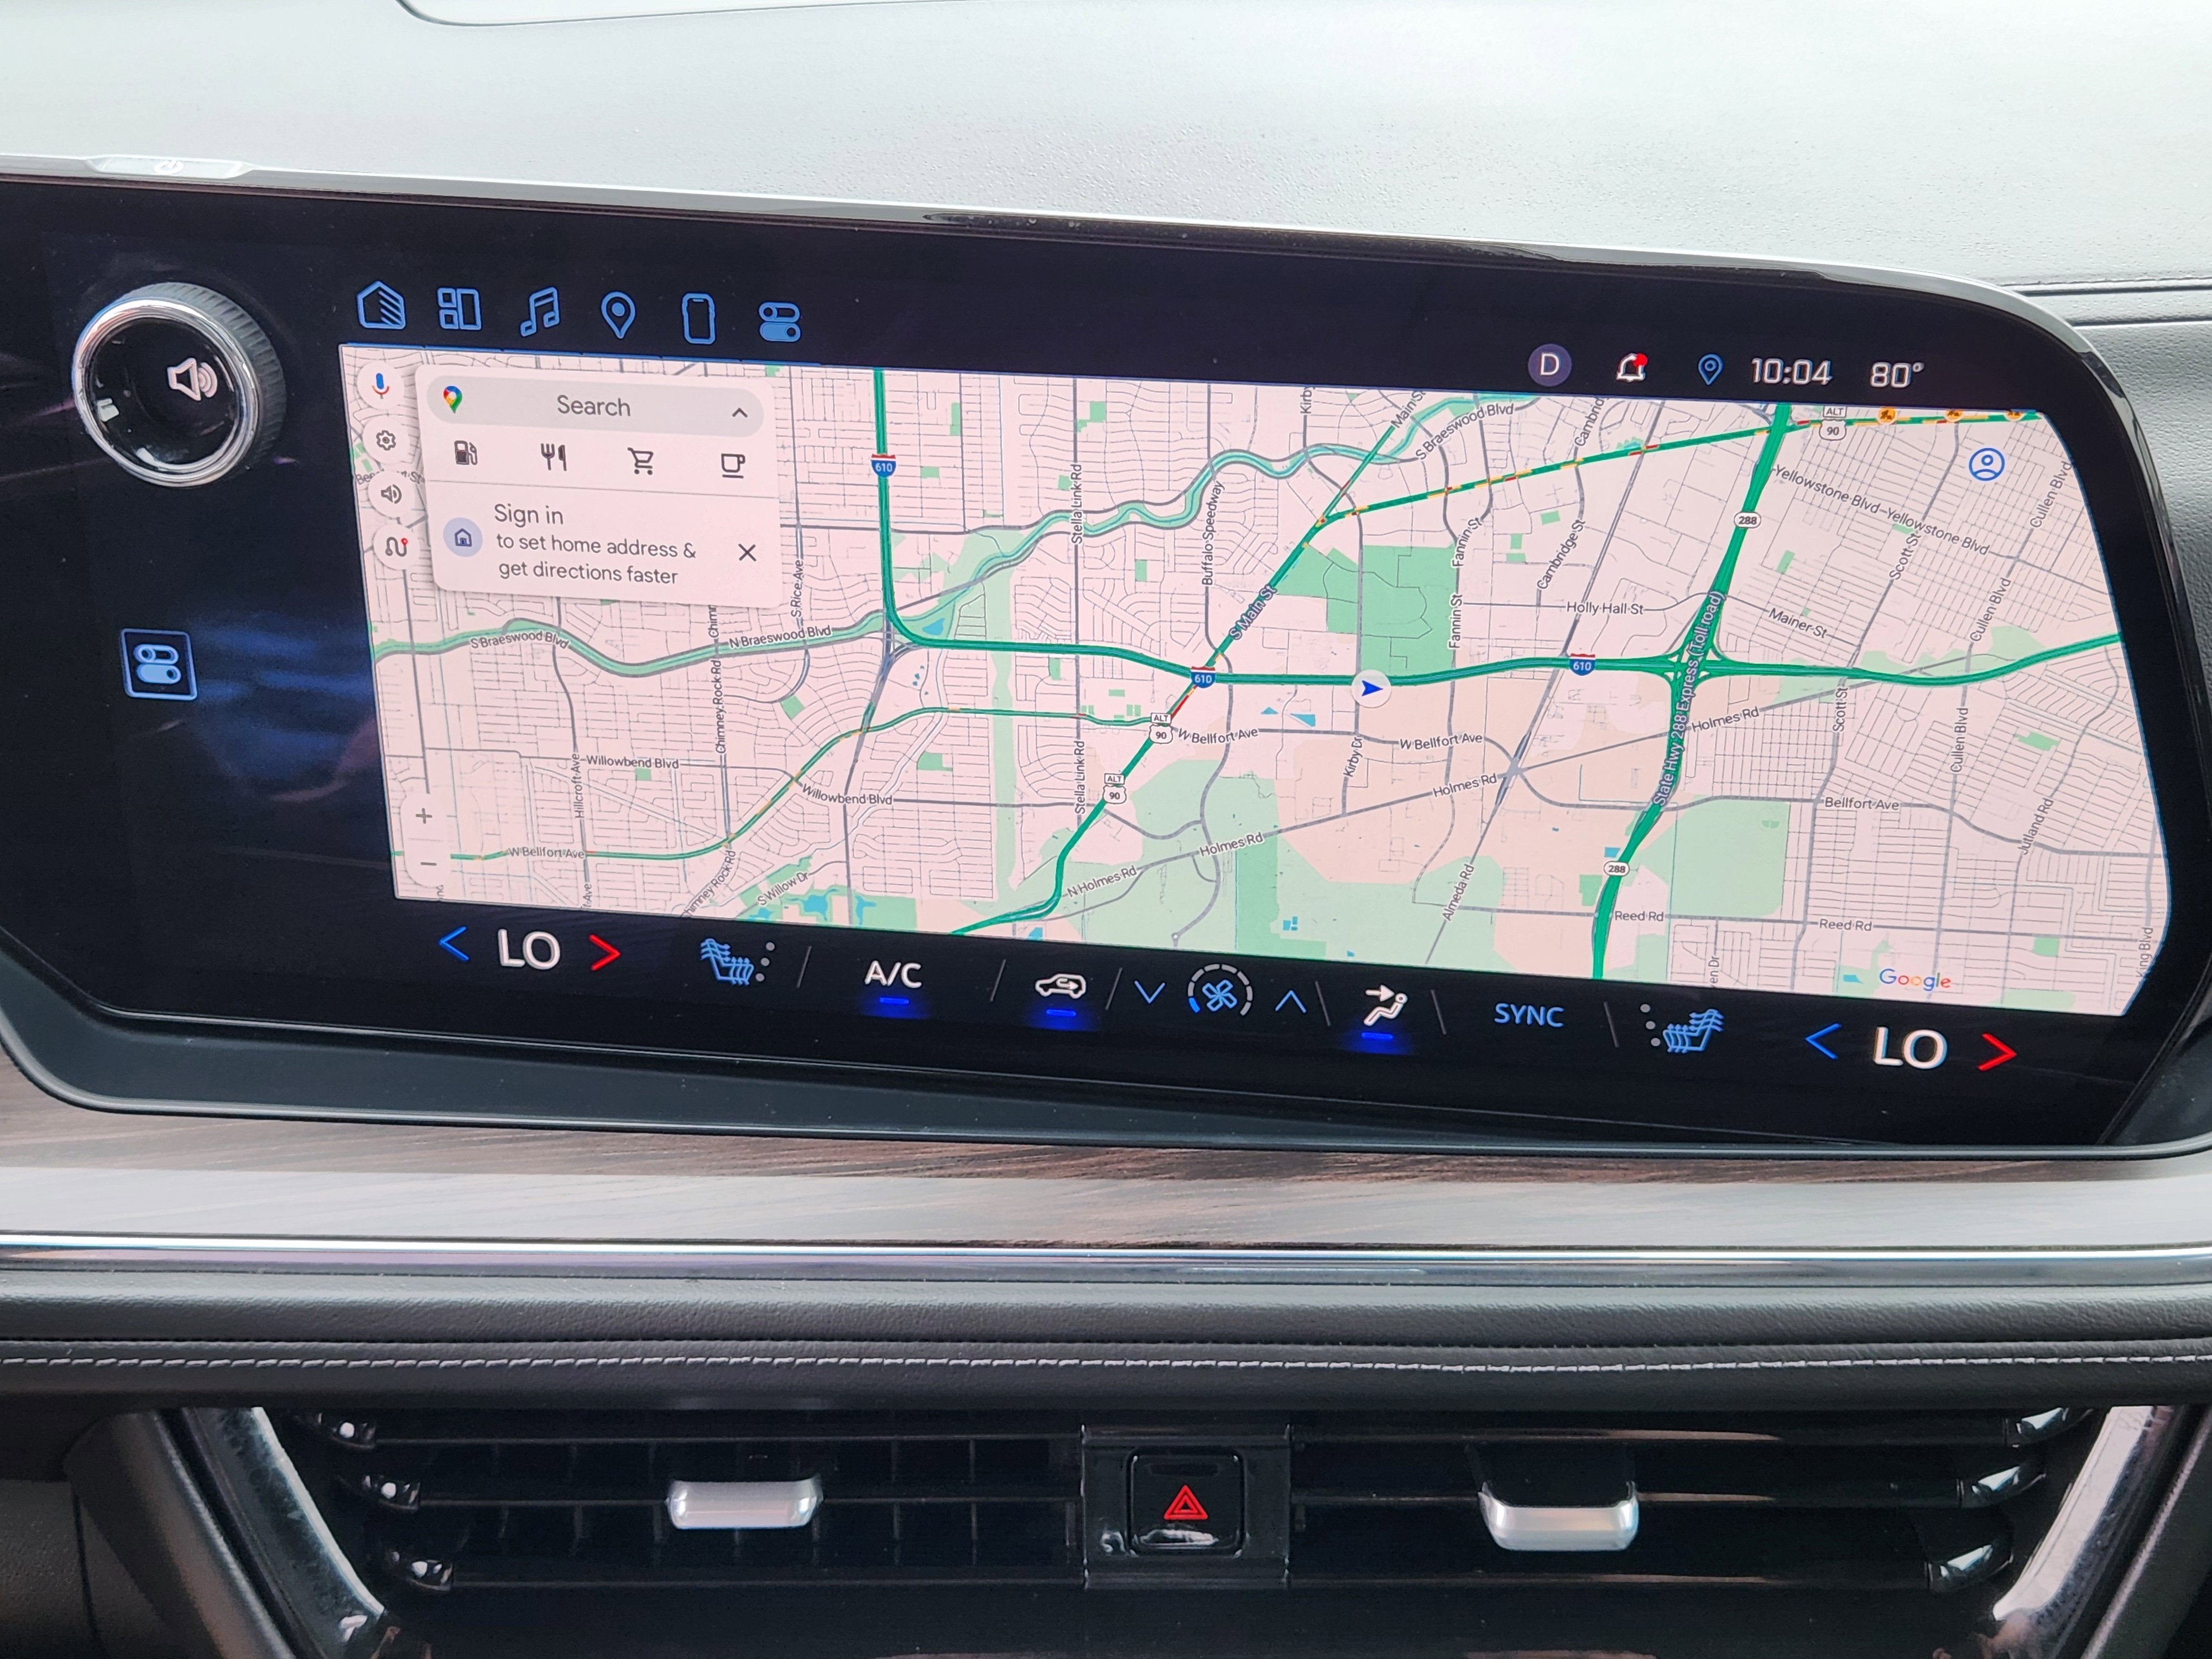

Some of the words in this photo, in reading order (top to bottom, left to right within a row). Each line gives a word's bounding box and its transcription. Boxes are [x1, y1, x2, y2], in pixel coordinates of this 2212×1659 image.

[1539, 352, 1560, 376] D
[1751, 358, 1833, 385] 10:04
[557, 395, 631, 418] Search
[1300, 387, 1315, 414] Kirb
[1825, 408, 1844, 416] ALT
[1390, 401, 1417, 428] Main
[1416, 449, 1426, 460] S
[1422, 406, 1485, 453] Braeswood
[1487, 403, 1514, 416] Blvd
[1826, 426, 1839, 435] 90
[875, 462, 893, 473] 610
[1071, 463, 1082, 481] Rd
[1071, 483, 1083, 508] Link
[1775, 464, 1850, 502] Yellowstone
[1851, 494, 1881, 513] Blvd
[2030, 490, 2057, 528] Cullen
[2049, 461, 2072, 489] Blvd
[494, 503, 539, 528] Sign
[546, 505, 564, 525] in
[1203, 481, 1225, 542] Speedway
[1738, 515, 1757, 525] 288
[1071, 510, 1083, 545] Stella
[1888, 507, 1960, 544] Yellowstone
[1961, 537, 1990, 555] Blvd
[497, 535, 514, 550] to
[518, 536, 547, 551] set
[551, 536, 601, 555] home
[606, 540, 678, 559] address
[683, 543, 696, 559] &
[1452, 529, 1471, 567] Fannin
[1468, 517, 1483, 531] St
[1537, 532, 1579, 589] Cambridge
[1572, 519, 1585, 533] St
[1201, 543, 1213, 586] Buffalo
[1889, 547, 1913, 580] Scott
[1906, 533, 1921, 550] St
[499, 562, 529, 581] get
[533, 561, 622, 582] directions
[627, 566, 679, 585] faster
[794, 559, 804, 580] Ave
[790, 582, 802, 608] Rice
[1450, 594, 1463, 607] St
[790, 609, 802, 618] S
[1229, 628, 1241, 639] S
[1237, 600, 1265, 630] Main
[1260, 586, 1276, 599] St
[1567, 602, 1599, 616] Holly
[1602, 603, 1627, 614] Hall
[1630, 604, 1644, 614] St
[1702, 591, 1725, 625] road)
[1970, 605, 1996, 642] Cullen
[1989, 577, 2011, 604] Blvd
[729, 638, 740, 648] N
[741, 629, 805, 646] Braeswood
[807, 624, 831, 637] Blvd
[1449, 608, 1461, 649] Fannin
[1770, 608, 1813, 633] Mainer
[1813, 625, 1827, 639] St
[470, 638, 478, 648] S
[479, 630, 543, 648] Braeswood
[545, 632, 569, 649] Blvd
[1687, 624, 1708, 656] (Toll
[711, 660, 721, 677] Rd
[1573, 661, 1592, 671] 610
[1194, 674, 1212, 685] 610
[1676, 660, 1698, 711] Express
[712, 679, 724, 706] Rock
[1835, 687, 1848, 700] St
[1153, 714, 1168, 723] ALT
[1672, 714, 1687, 740] 288
[1692, 713, 1740, 733] Holmes
[1743, 707, 1760, 719] Rd
[1833, 701, 1847, 732] Scott
[1954, 707, 1969, 733] Blvd
[713, 706, 726, 753] Chimney
[1156, 731, 1167, 740] 90
[1178, 728, 1190, 739] W
[1191, 732, 1234, 744] Bellfort
[1238, 728, 1258, 738] Ave
[1399, 739, 1413, 749] W
[1414, 735, 1459, 749] Bellfort
[1461, 733, 1483, 744] Ave
[1074, 740, 1085, 755] Rd
[1352, 737, 1364, 748] Dr
[1950, 735, 1965, 773] Cullen
[571, 753, 580, 772] Ave
[586, 755, 651, 768] Willowbend
[655, 758, 679, 769] Blvd
[1074, 757, 1086, 781] Link
[1343, 746, 1364, 777] Kirby
[1663, 742, 1685, 772] Hwy
[573, 776, 585, 818] Hillcroft
[802, 785, 866, 805] Willowbend
[868, 794, 893, 805] Blvd
[1074, 782, 1086, 814] Stella
[1109, 791, 1120, 800] 90
[1433, 780, 1480, 797] Holmes
[1481, 774, 1497, 784] Rd
[1653, 773, 1673, 806] State
[1824, 796, 1872, 810] Bellfort
[1876, 798, 1900, 811] Ave
[2018, 812, 2047, 855] Jutland
[2037, 799, 2054, 816] Rd
[508, 847, 520, 857] W
[522, 847, 563, 857] Bellfort
[565, 848, 585, 859] Ave
[1199, 838, 1245, 856] Holmes
[1244, 832, 1264, 845] Rd
[711, 865, 732, 888] Rock
[724, 849, 735, 864] Rd
[1608, 864, 1626, 873] 288
[583, 883, 592, 902] Ave
[757, 896, 766, 906] S
[766, 879, 797, 900] Willow
[796, 872, 808, 882] Dr
[1067, 886, 1078, 897] N
[1078, 873, 1121, 895] Holmes
[1121, 866, 1138, 880] Rd
[1442, 880, 1467, 921] Almeda
[1460, 864, 1474, 880] Rd
[1614, 911, 1645, 921] Reed
[1648, 911, 1665, 922] Rd
[1819, 919, 1852, 930] Reed
[1854, 920, 1872, 931] Rd
[498, 928, 561, 969] LO
[2138, 927, 2153, 951] Blvd
[865, 961, 922, 988] A/C
[1708, 956, 1720, 968] Dr
[1879, 968, 1951, 990] Google
[1494, 1003, 1564, 1028] SYNC
[1874, 1026, 1948, 1070] LO
